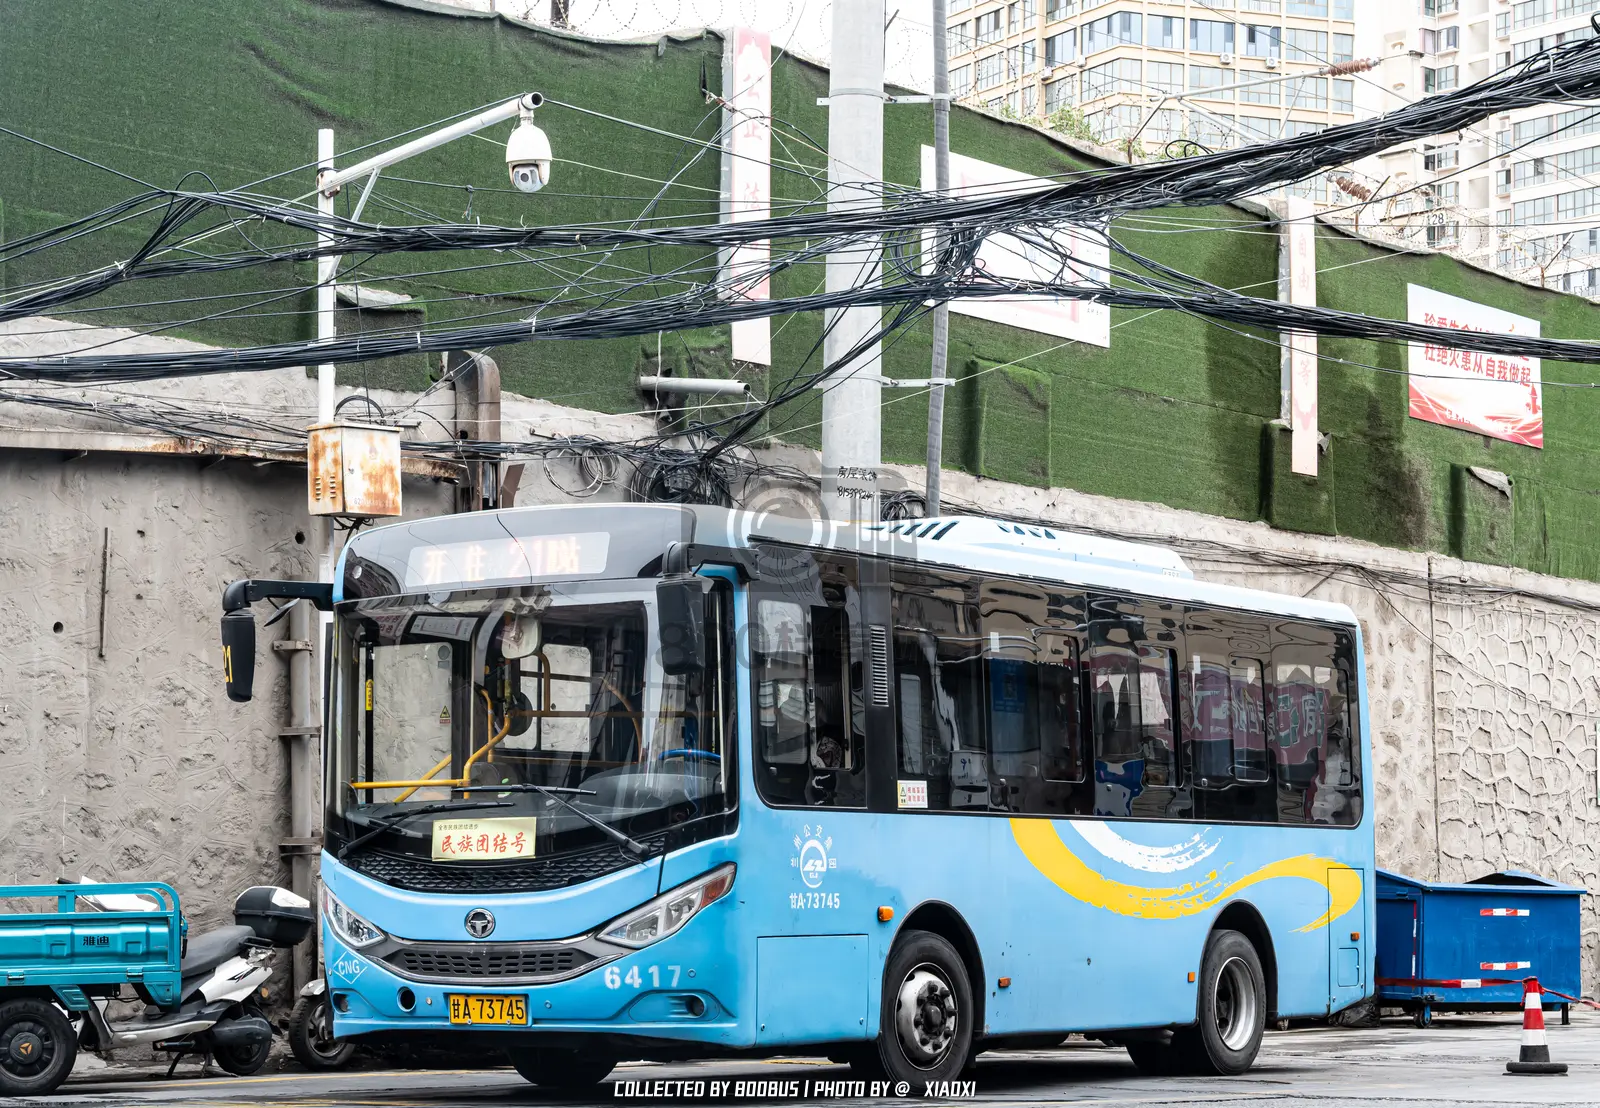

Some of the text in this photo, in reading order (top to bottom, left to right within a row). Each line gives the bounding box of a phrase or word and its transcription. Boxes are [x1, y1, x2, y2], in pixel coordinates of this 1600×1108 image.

[1423, 343, 1532, 388] 杜绝火患从自我做起
[441, 831, 527, 855] 民族团结号
[82, 935, 110, 947] 雅迪
[338, 960, 360, 975] CNG
[604, 965, 682, 989] 6417
[452, 998, 525, 1021] 甘A·73745
